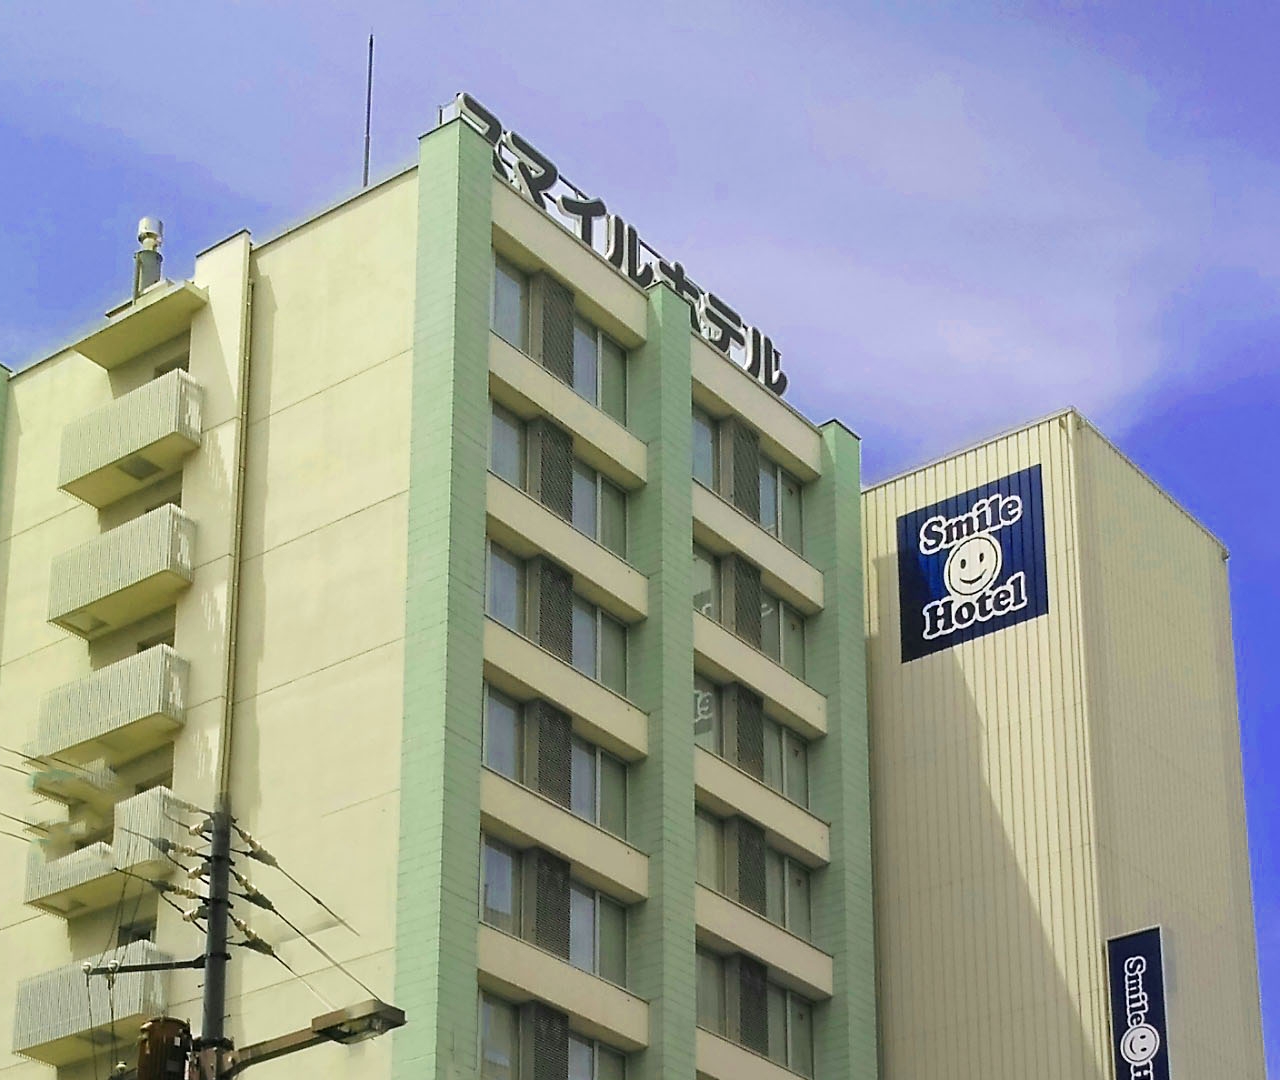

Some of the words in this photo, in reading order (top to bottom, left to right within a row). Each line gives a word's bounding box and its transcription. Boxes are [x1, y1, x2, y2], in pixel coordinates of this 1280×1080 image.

[920, 494, 1023, 555] Smile
[922, 572, 1027, 640] Hotel
[1124, 955, 1150, 1027] Smile
